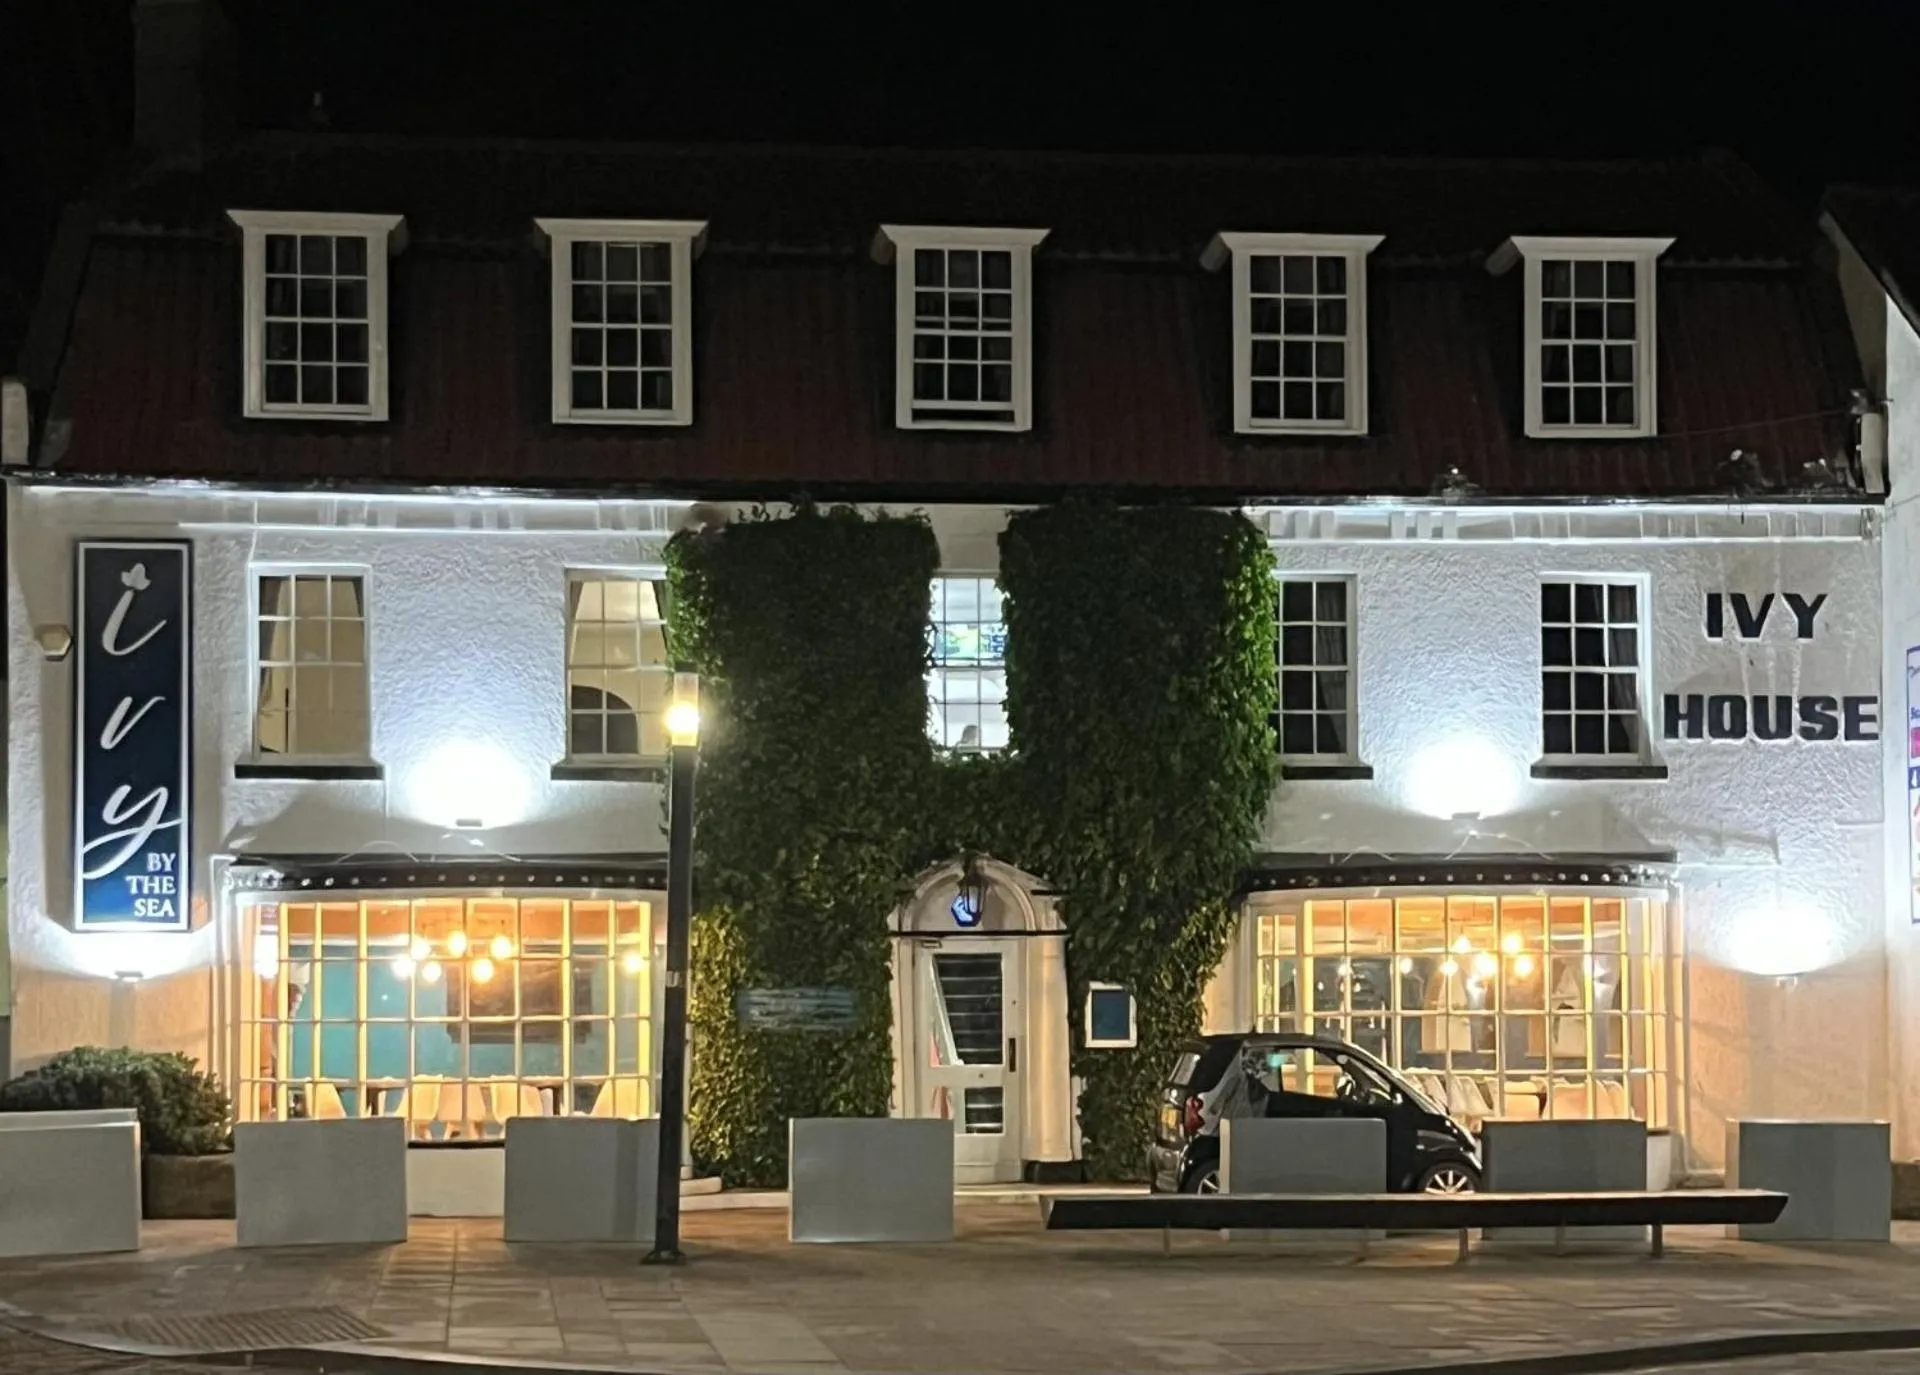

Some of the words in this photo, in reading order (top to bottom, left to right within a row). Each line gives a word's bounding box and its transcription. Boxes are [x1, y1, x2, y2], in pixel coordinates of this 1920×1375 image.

[1706, 593, 1828, 638] IVY
[83, 563, 183, 879] ivy
[1664, 694, 1879, 740] HOUSE
[147, 852, 176, 872] BY
[125, 875, 176, 894] THE
[134, 898, 175, 917] SEA
